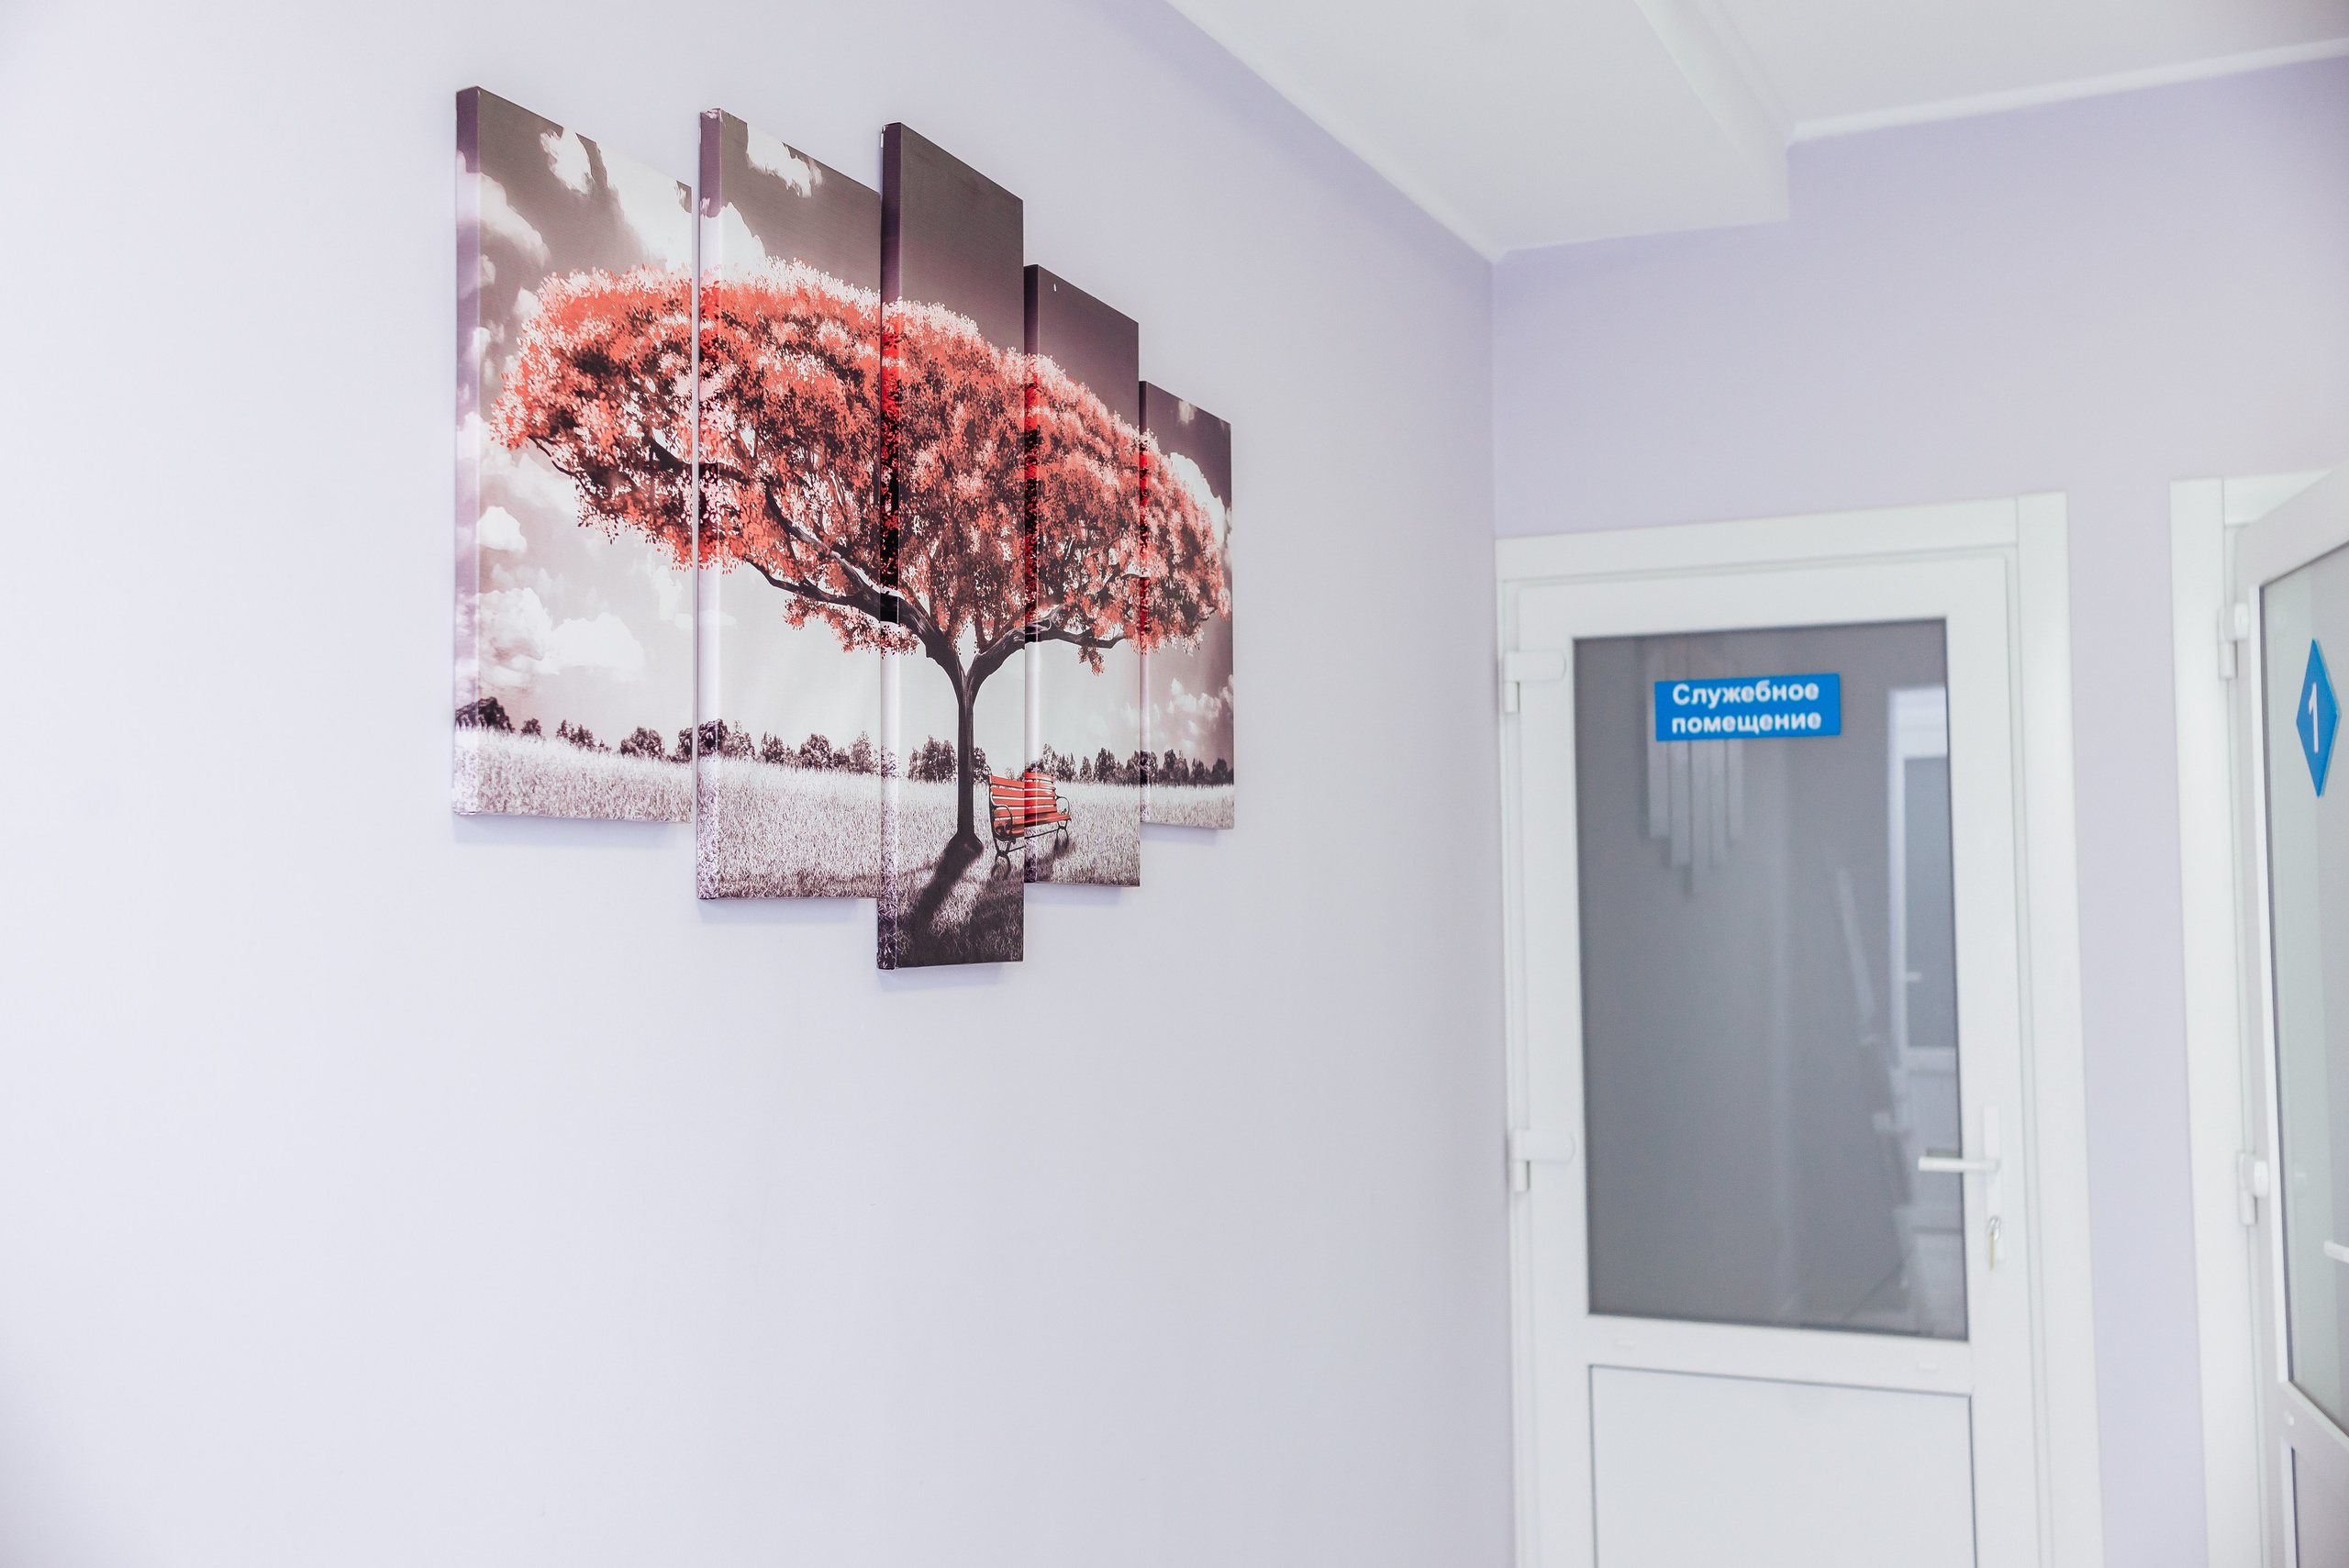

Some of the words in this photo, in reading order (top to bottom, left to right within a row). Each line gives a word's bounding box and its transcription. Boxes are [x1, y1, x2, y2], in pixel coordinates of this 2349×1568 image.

[1672, 679, 1820, 709] Служебное
[1672, 712, 1821, 735] помещение
[2308, 682, 2319, 754] 1
